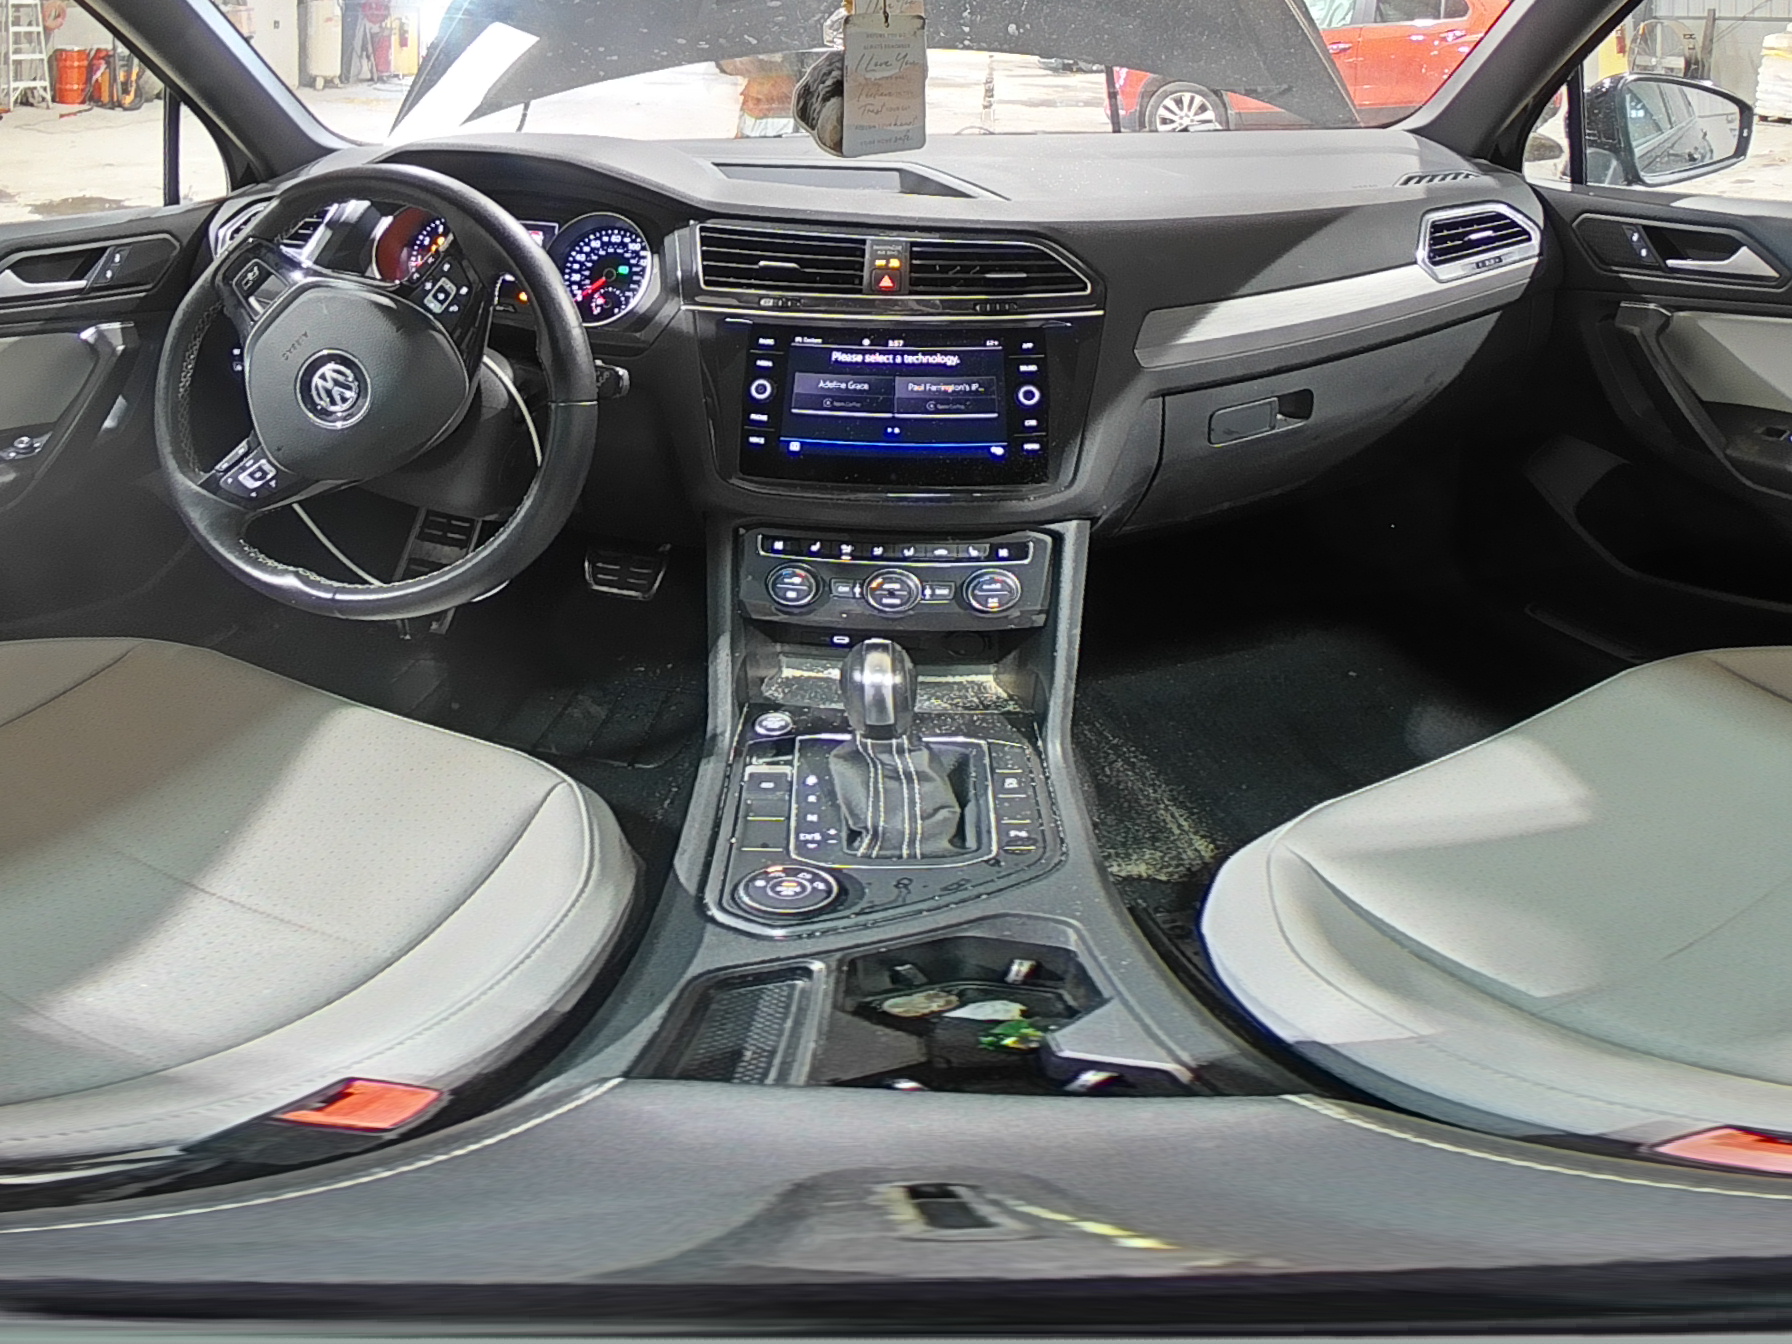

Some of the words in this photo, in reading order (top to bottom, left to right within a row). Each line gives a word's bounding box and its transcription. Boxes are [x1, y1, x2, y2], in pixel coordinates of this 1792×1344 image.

[864, 53, 892, 72] Love
[895, 52, 920, 72] You
[857, 102, 885, 116] Trust
[831, 351, 863, 365] Please
[864, 352, 894, 365] select
[895, 355, 902, 365] a
[904, 352, 961, 367] technology.
[908, 383, 925, 392] Paul
